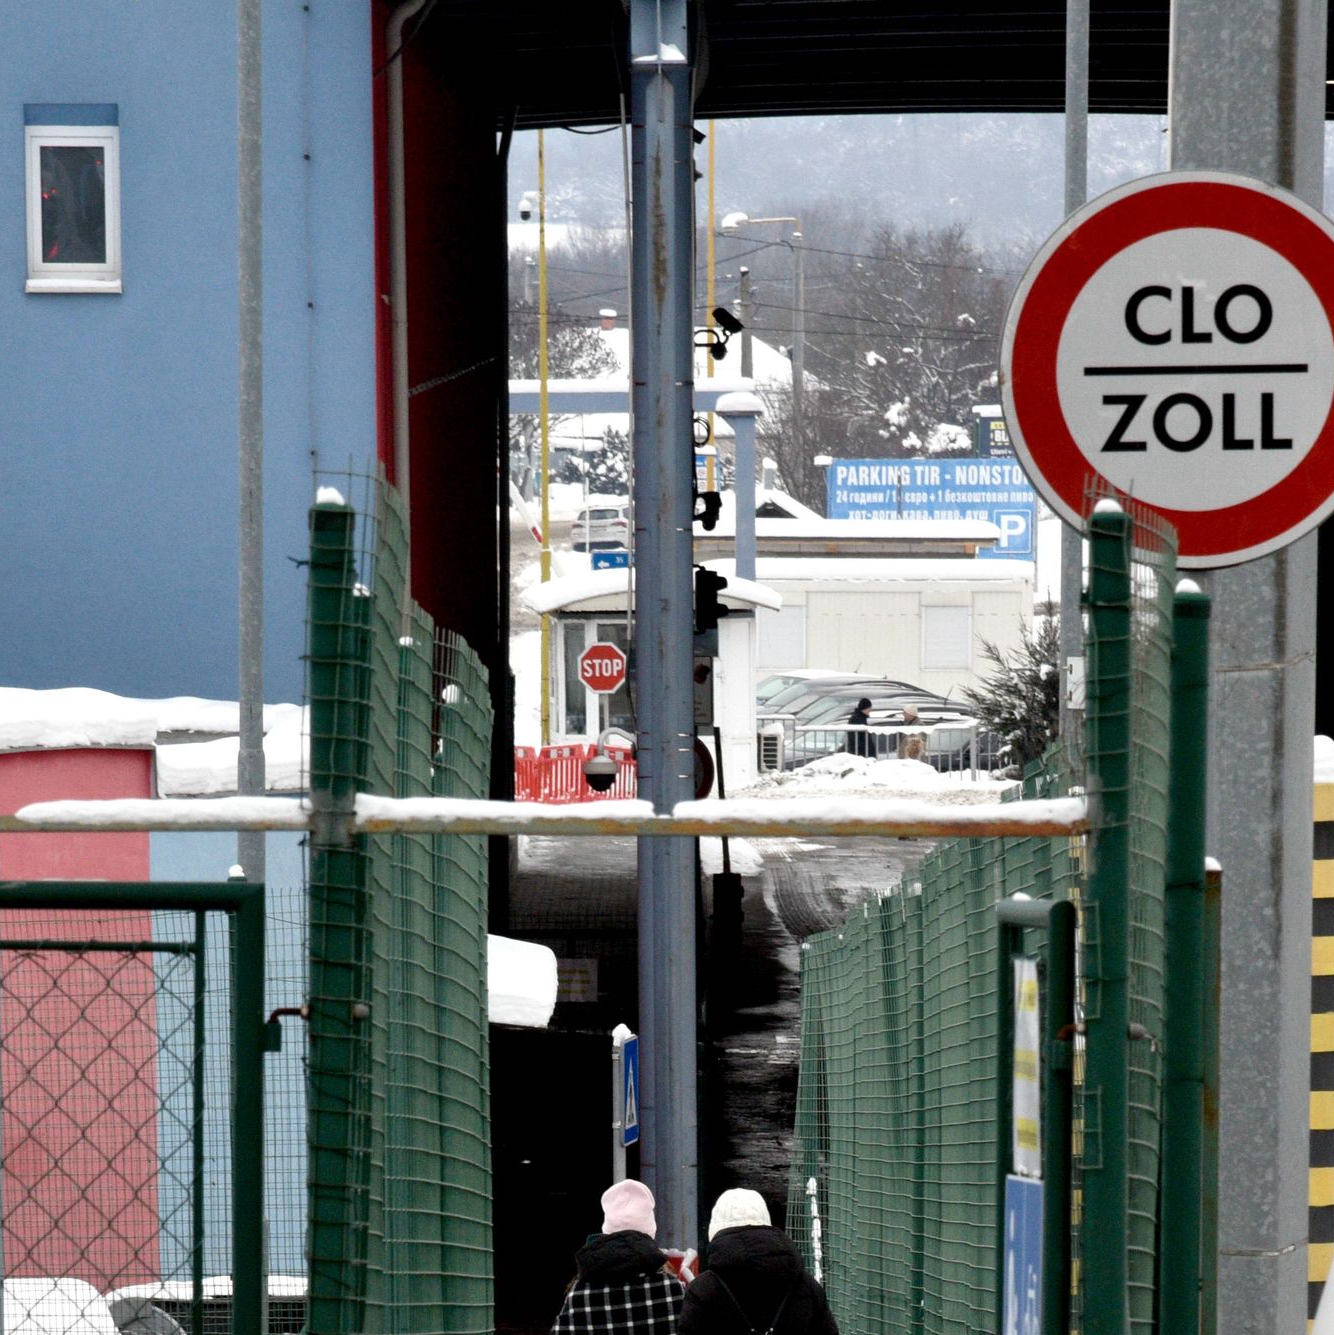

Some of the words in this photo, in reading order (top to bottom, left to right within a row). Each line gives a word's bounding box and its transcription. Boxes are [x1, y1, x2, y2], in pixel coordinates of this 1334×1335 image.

[1124, 284, 1273, 345] CLO
[1100, 392, 1293, 452] ZOLL
[836, 465, 910, 486] PARKING
[915, 466, 940, 486] TIR
[955, 465, 1029, 486] NONSTO
[836, 490, 849, 503] 24
[850, 492, 884, 505] години
[904, 492, 928, 505] євро
[929, 492, 936, 502] +
[937, 490, 942, 502] 1
[945, 489, 1009, 503] безкоштовне
[1010, 492, 1034, 503] пиво
[1000, 514, 1026, 548] P
[583, 659, 623, 677] STOP
